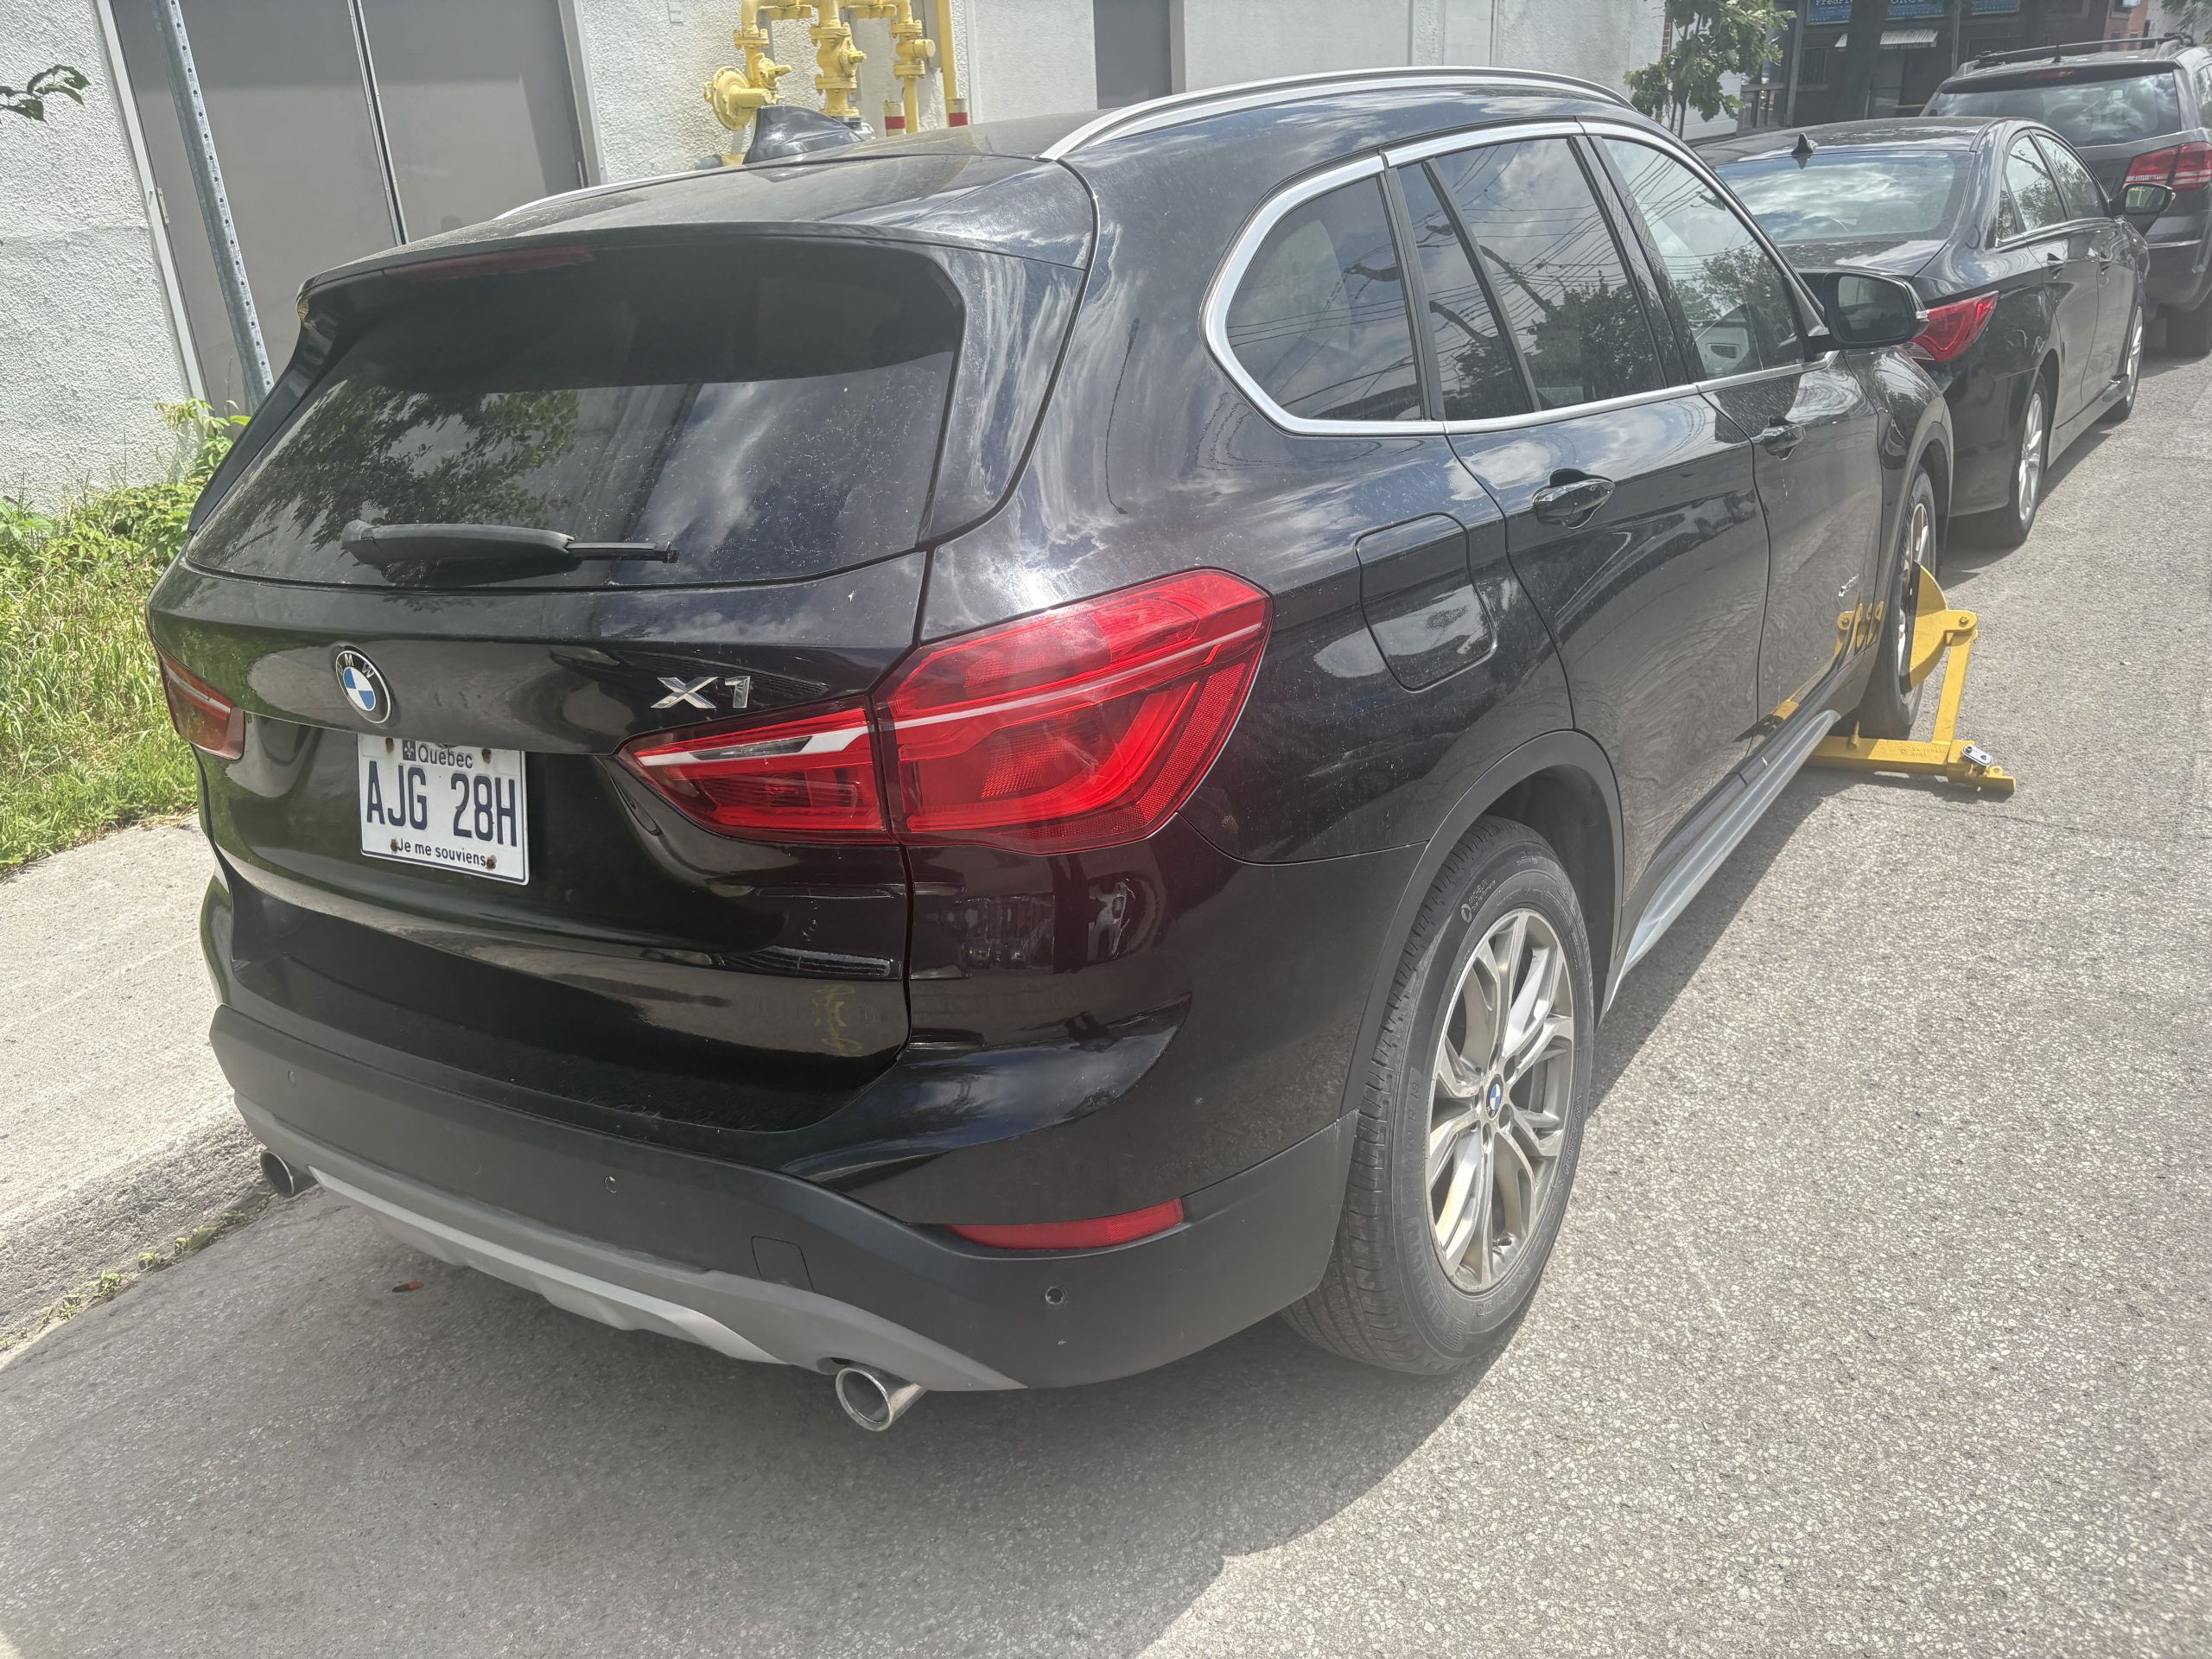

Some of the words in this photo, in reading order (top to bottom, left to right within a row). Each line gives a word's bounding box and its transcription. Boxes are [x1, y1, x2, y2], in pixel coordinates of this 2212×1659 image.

[337, 653, 375, 678] BMW
[650, 676, 751, 709] X1
[366, 760, 428, 830] AJG
[450, 772, 518, 848] 28H
[397, 838, 411, 852] Je
[415, 843, 432, 856] me
[435, 847, 486, 867] souviens
